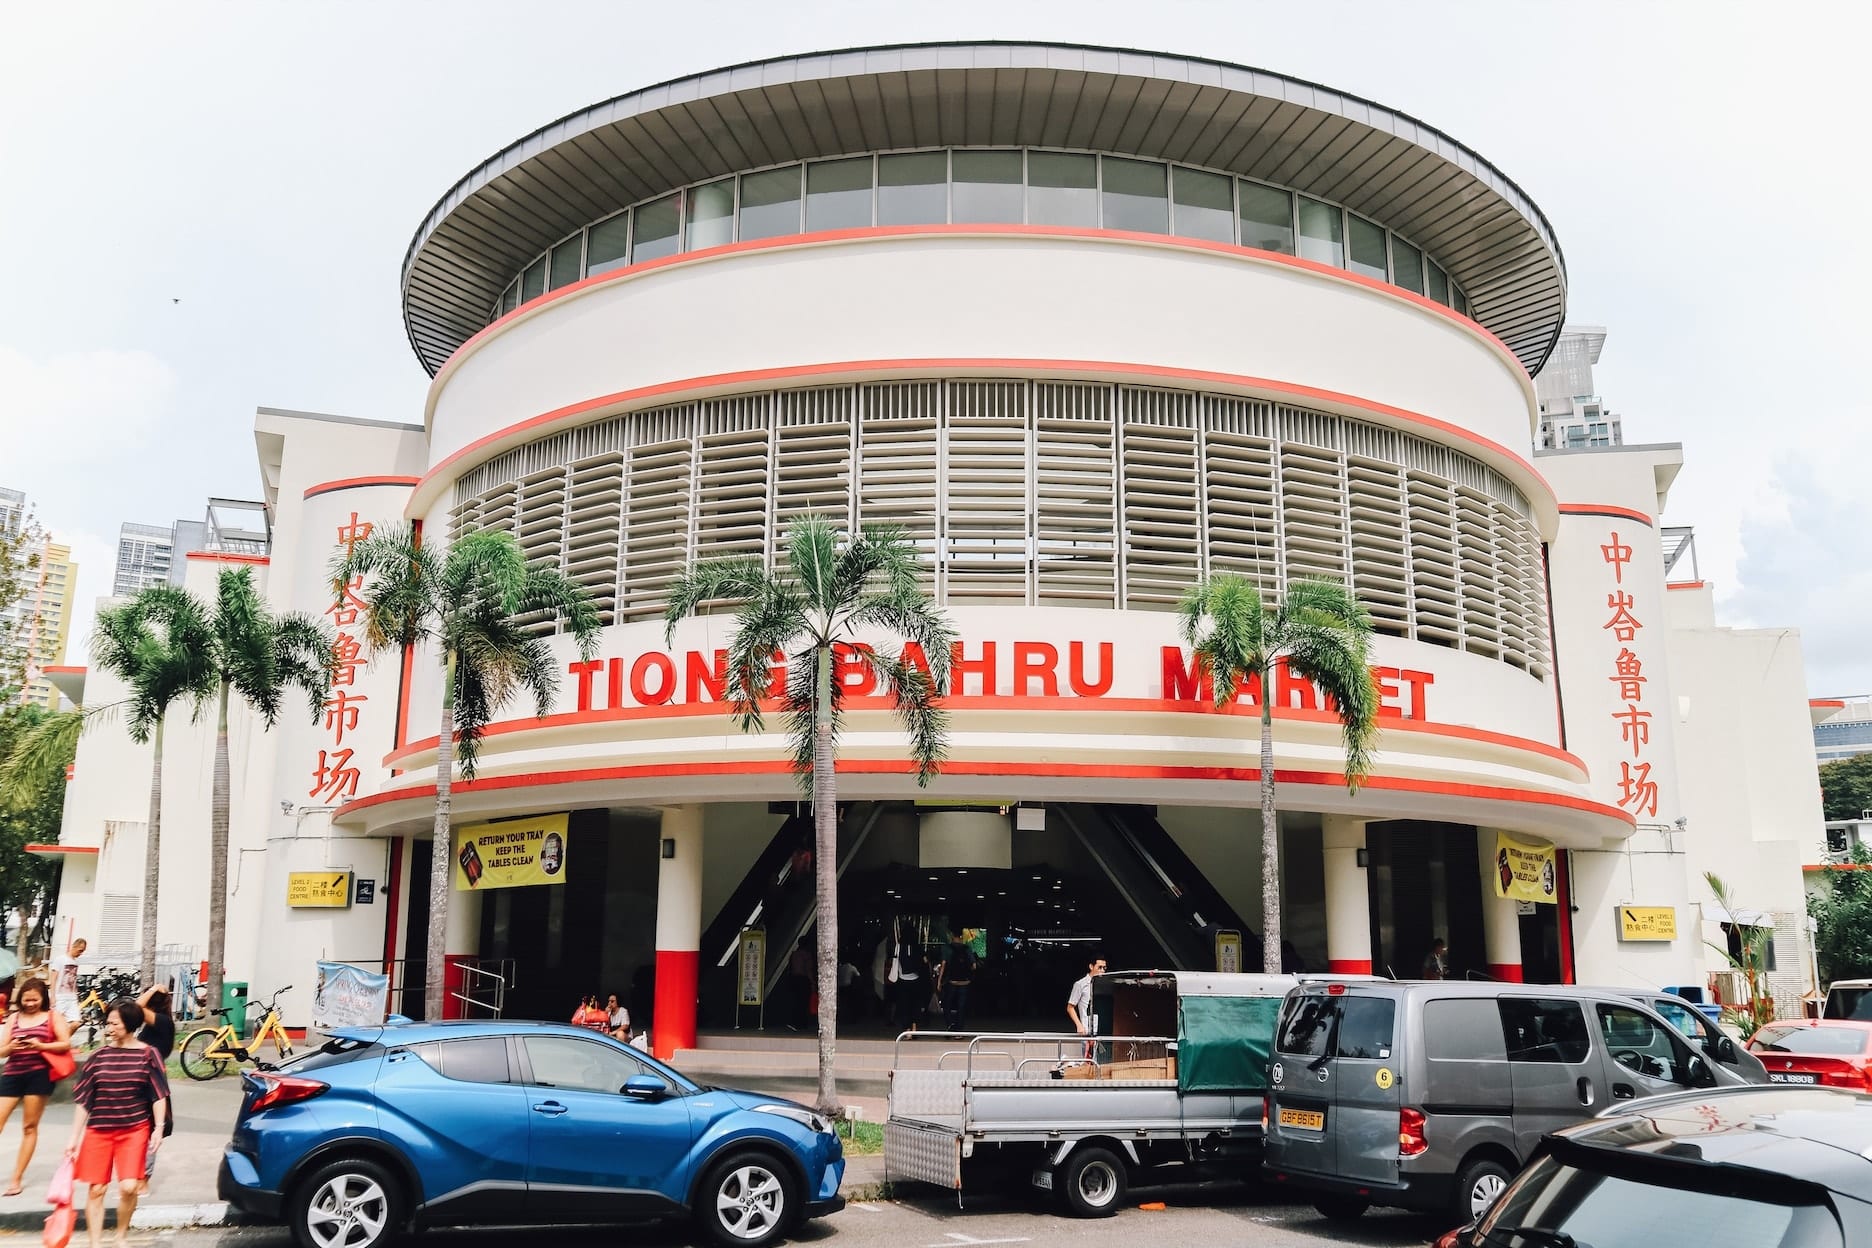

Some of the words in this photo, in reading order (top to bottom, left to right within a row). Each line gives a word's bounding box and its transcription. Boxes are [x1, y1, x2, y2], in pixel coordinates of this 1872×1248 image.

[832, 640, 1114, 698] BAHRU
[1160, 645, 1435, 722] MARET
[1600, 531, 1658, 819] 中峇鲁市场
[478, 834, 505, 847] RETURN
[506, 832, 526, 843] YOUR
[526, 829, 544, 840] TRAY
[495, 846, 512, 856] KEEP
[513, 844, 526, 854] THE
[488, 858, 512, 869] TABLES
[512, 856, 534, 867] CLEAN
[1381, 1071, 1388, 1081] 6
